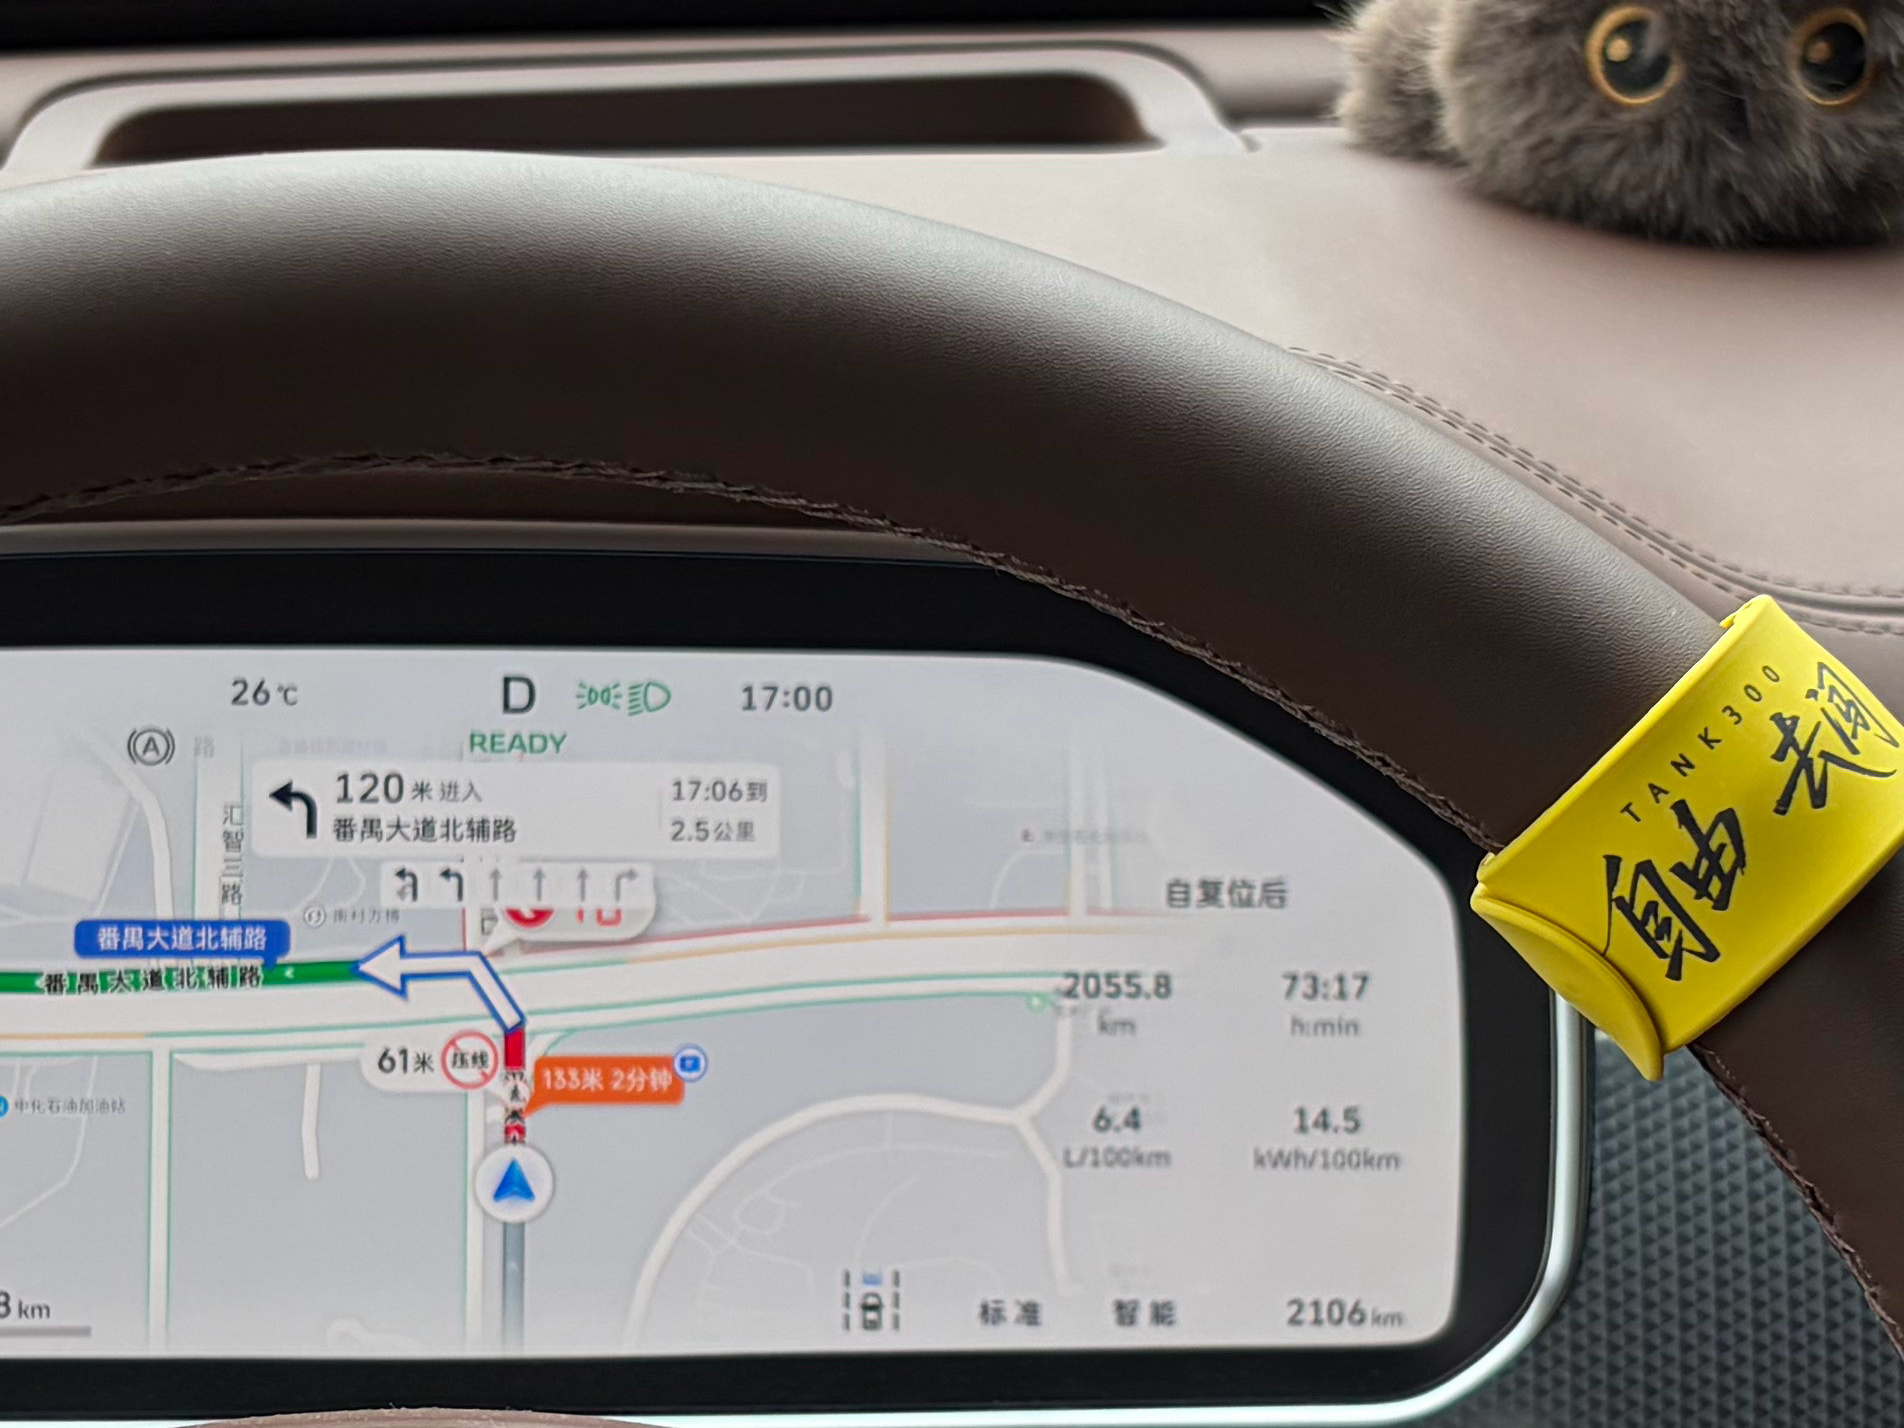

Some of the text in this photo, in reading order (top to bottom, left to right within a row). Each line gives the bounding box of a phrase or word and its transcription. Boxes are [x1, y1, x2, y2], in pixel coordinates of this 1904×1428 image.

[501, 675, 537, 715] D
[740, 684, 834, 713] 17:00
[469, 732, 568, 755] READY
[332, 816, 518, 844] 番禺大道北辅路
[1166, 877, 1289, 910] 自复位后
[97, 926, 269, 952] 番禺大道北辅路
[1062, 972, 1173, 1001] 2055.8
[1282, 973, 1370, 1001] 73:17
[1097, 1014, 1137, 1036] km
[1092, 1105, 1143, 1134] 6.4
[1292, 1107, 1361, 1133] 14.5
[1062, 1145, 1172, 1171] L/100km
[1253, 1147, 1401, 1173] kWh/100km
[1112, 1298, 1177, 1327] 智能
[1286, 1298, 1367, 1328] 2106
